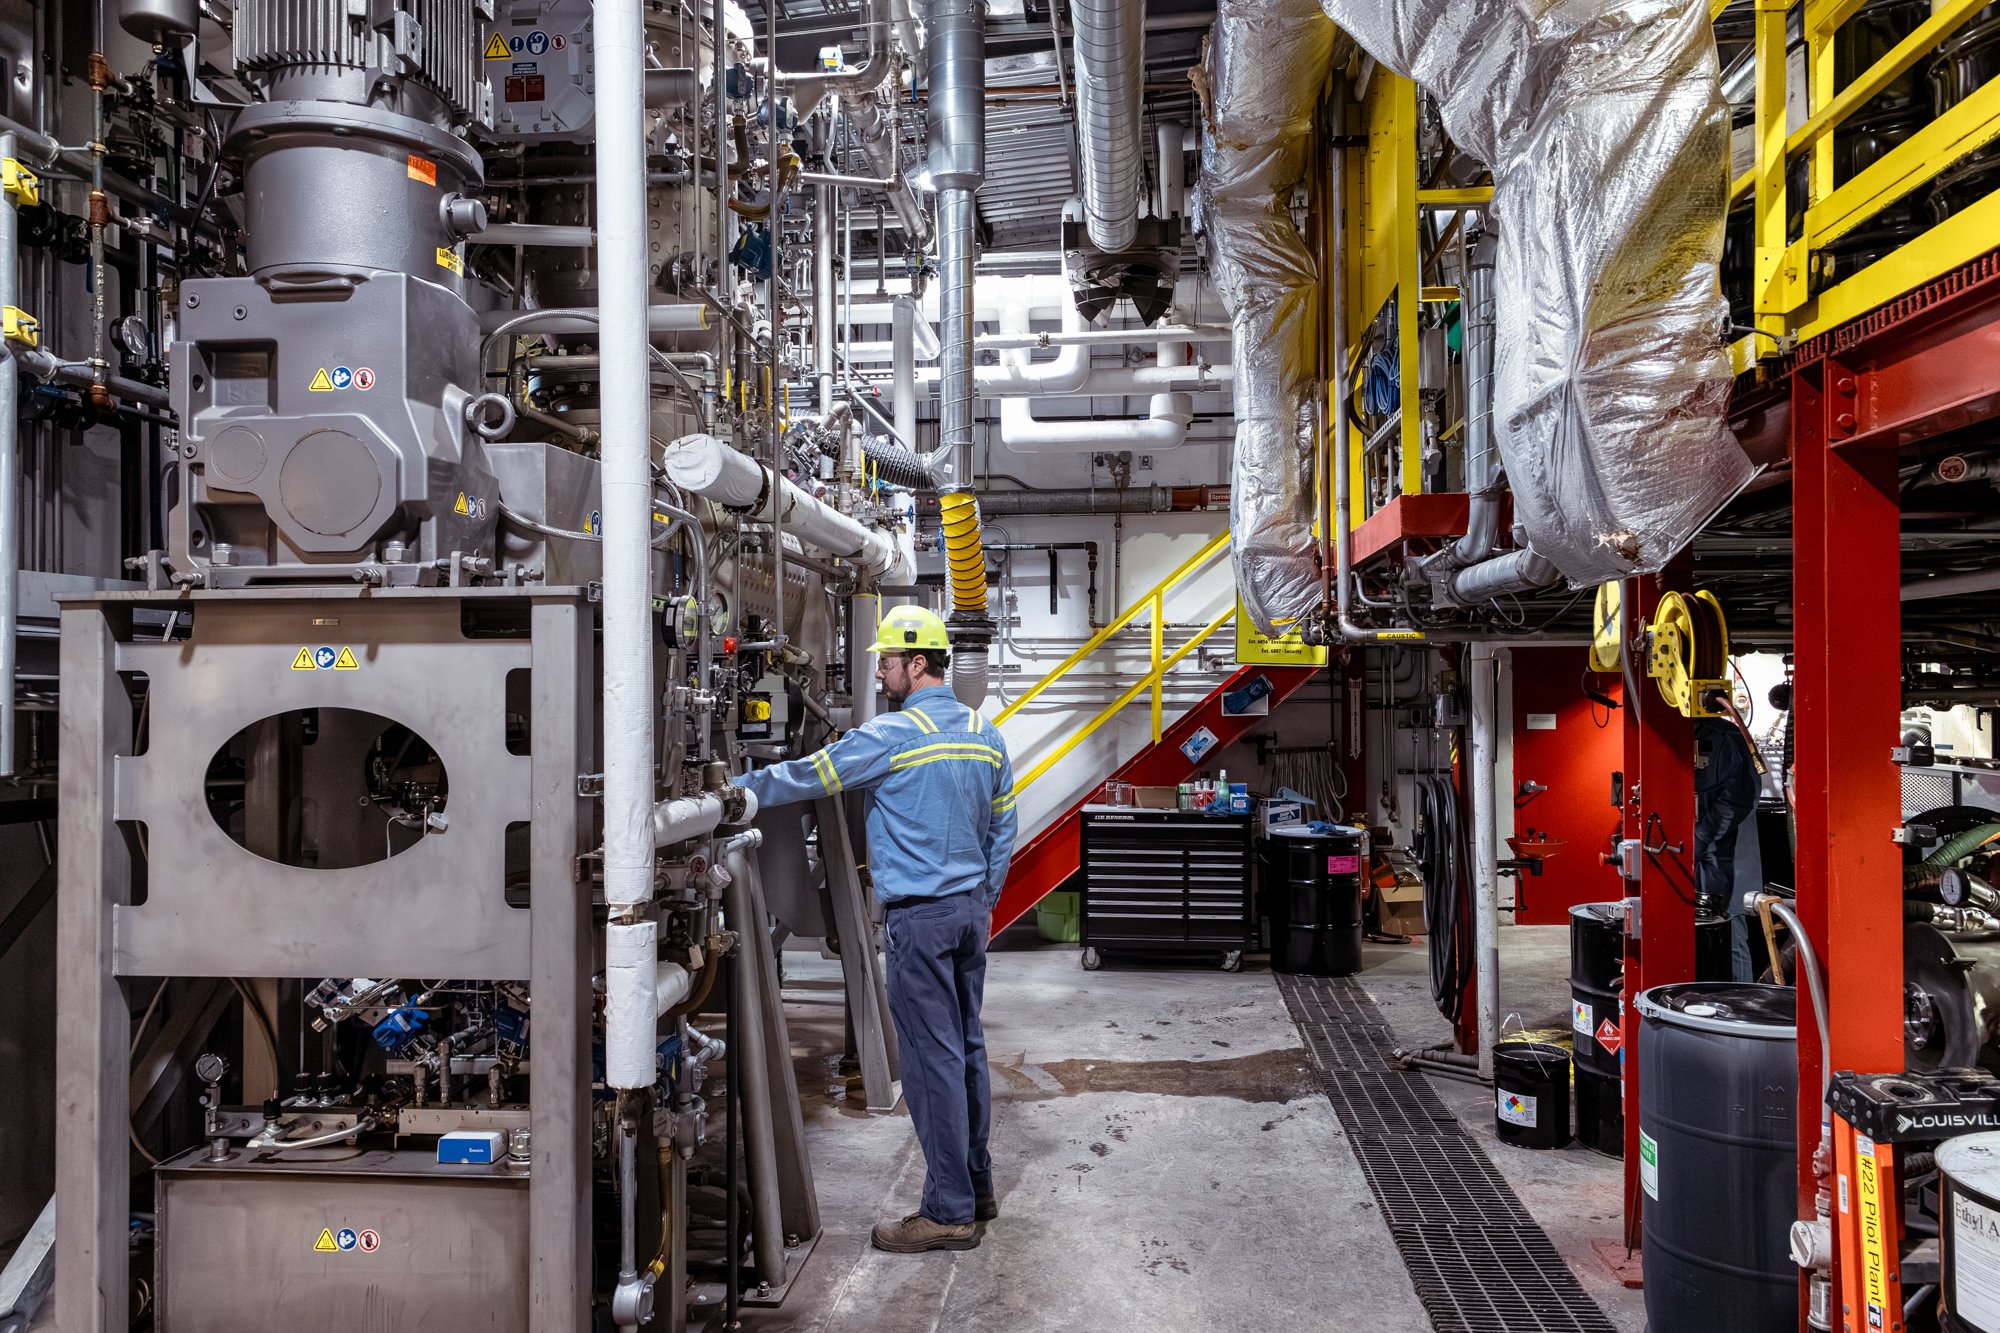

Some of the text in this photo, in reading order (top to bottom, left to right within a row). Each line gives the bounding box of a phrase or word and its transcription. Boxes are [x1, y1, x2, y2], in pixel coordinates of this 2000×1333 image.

[1861, 1157, 1875, 1195] #22
[1865, 1200, 1878, 1245] Pilot
[1955, 1201, 1984, 1230] Ethyl
[1868, 1251, 1882, 1303] Plant
